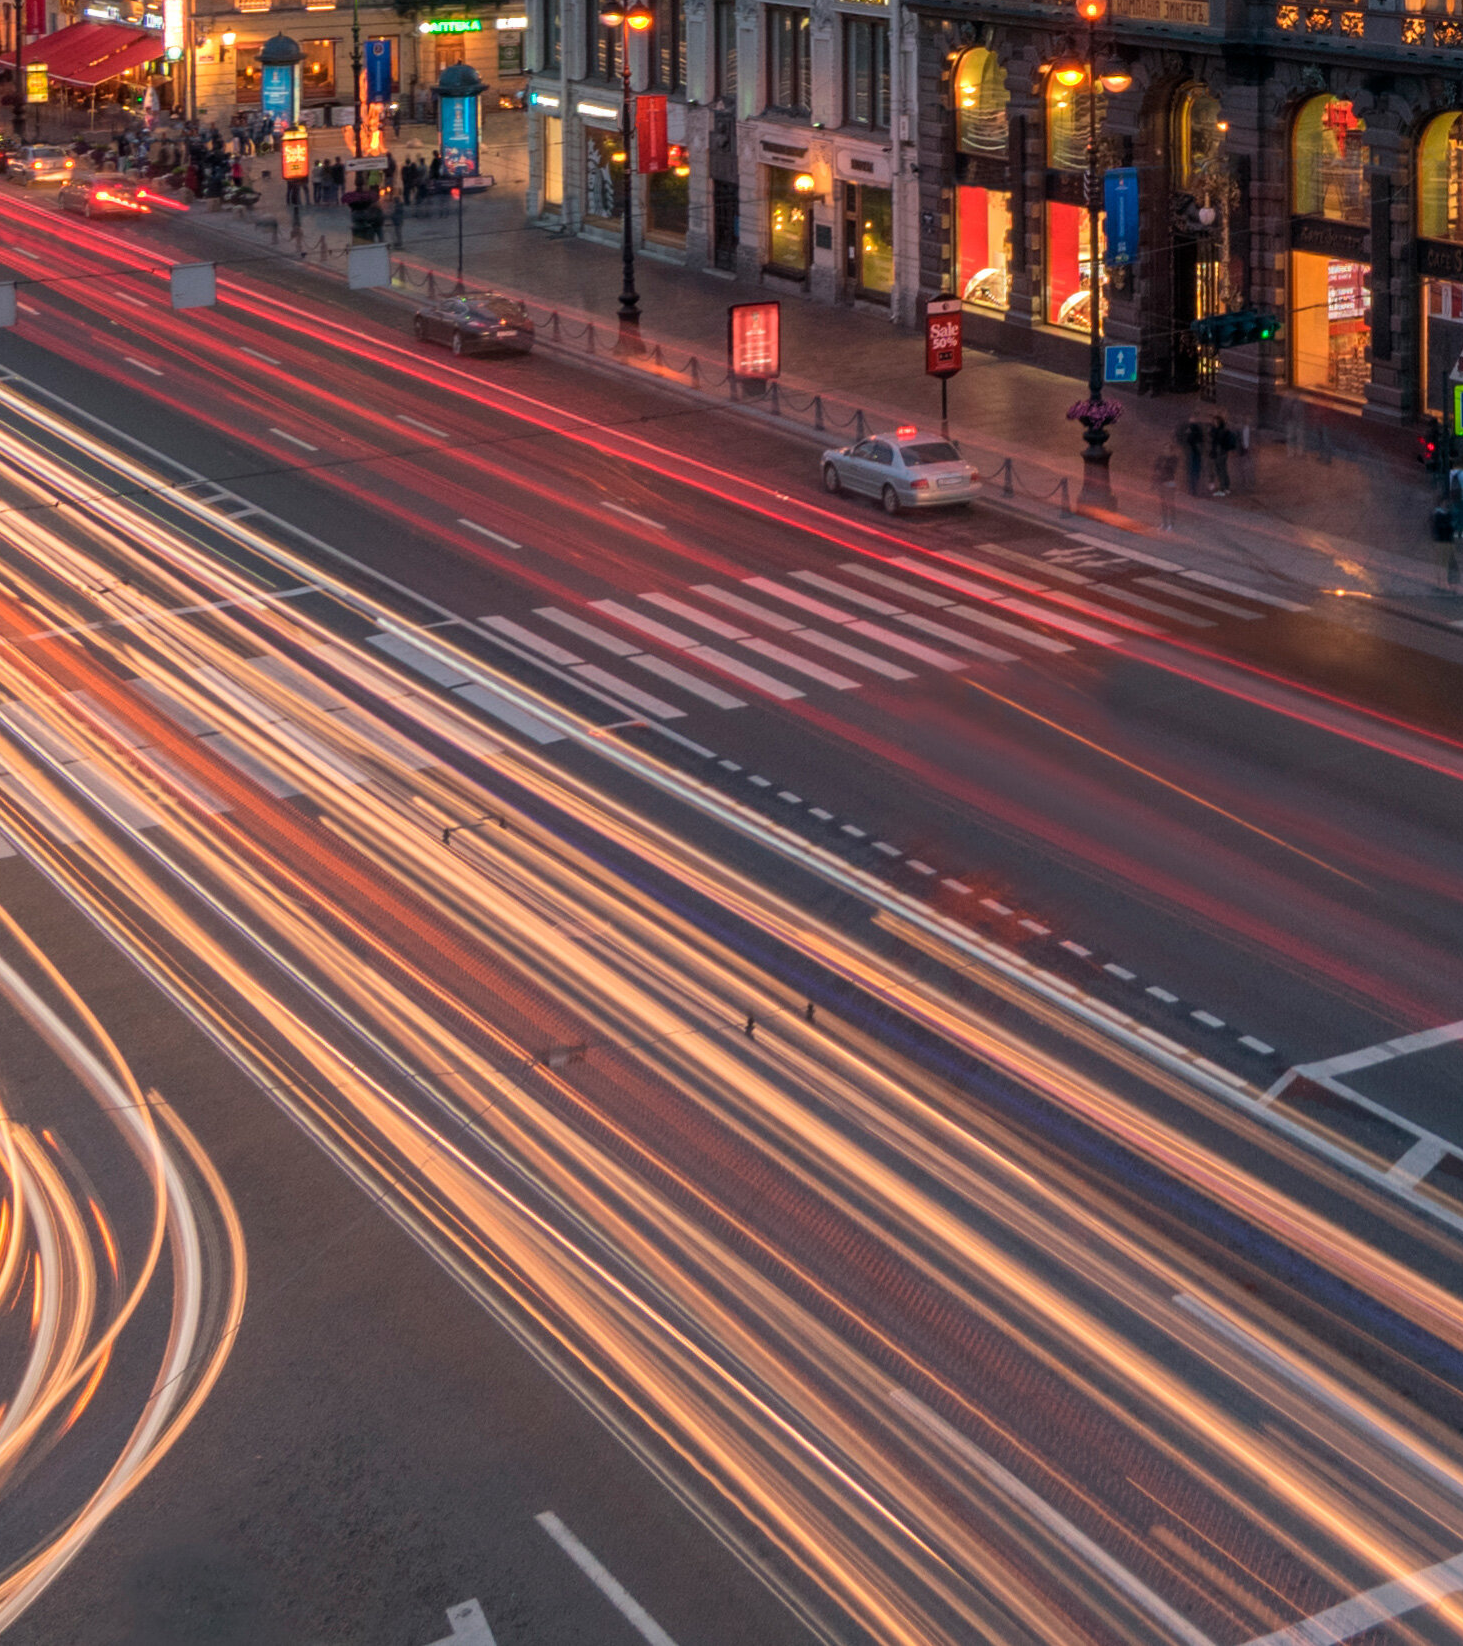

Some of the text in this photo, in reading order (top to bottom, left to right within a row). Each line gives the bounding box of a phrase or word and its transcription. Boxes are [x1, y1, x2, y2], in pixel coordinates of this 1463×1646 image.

[430, 19, 481, 32] АПТЕКА
[930, 322, 959, 339] Sale
[932, 338, 958, 350] 50%
